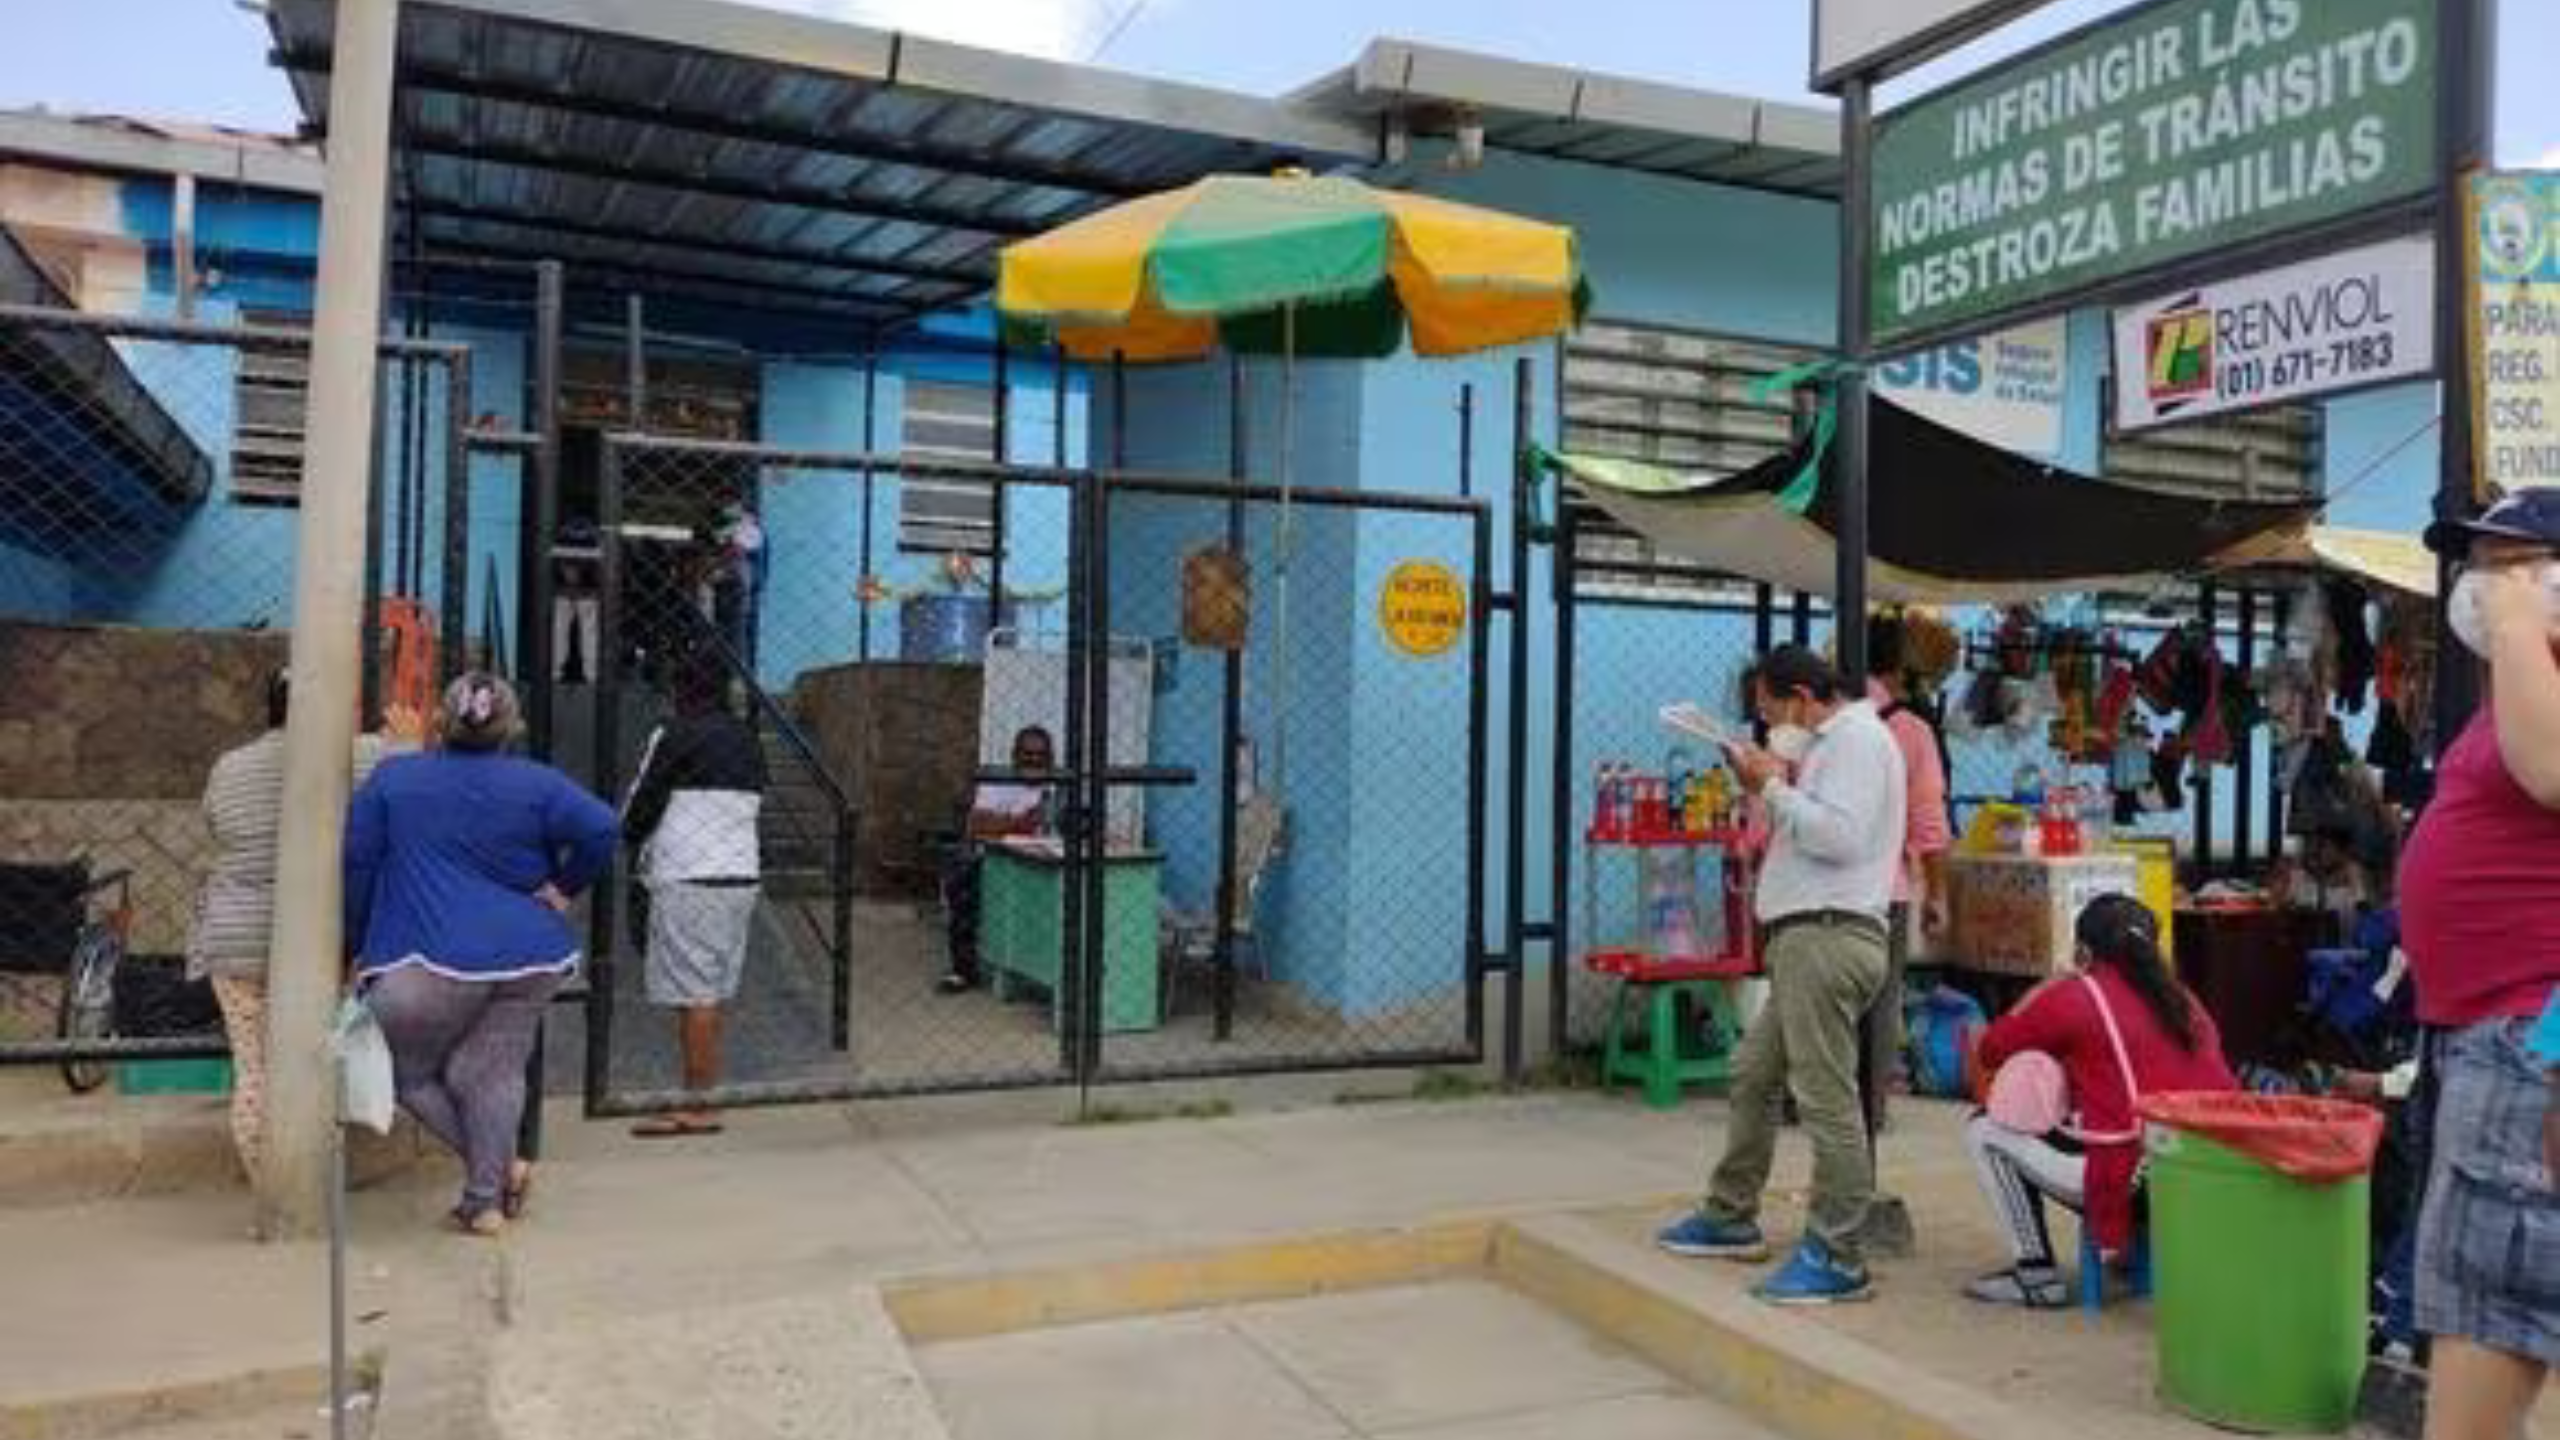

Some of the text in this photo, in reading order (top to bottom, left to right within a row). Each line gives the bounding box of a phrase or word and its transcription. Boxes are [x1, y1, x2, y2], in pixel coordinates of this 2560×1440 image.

[1880, 16, 2416, 254] NORMAS DE TRÁNSITO
[1954, 0, 2300, 160] INFRINGIR LAS
[1897, 114, 2385, 316] DESTROZA FAMILIAS
[2216, 272, 2393, 353] RENVIOL
[2216, 331, 2394, 400] (01) 671-7183
